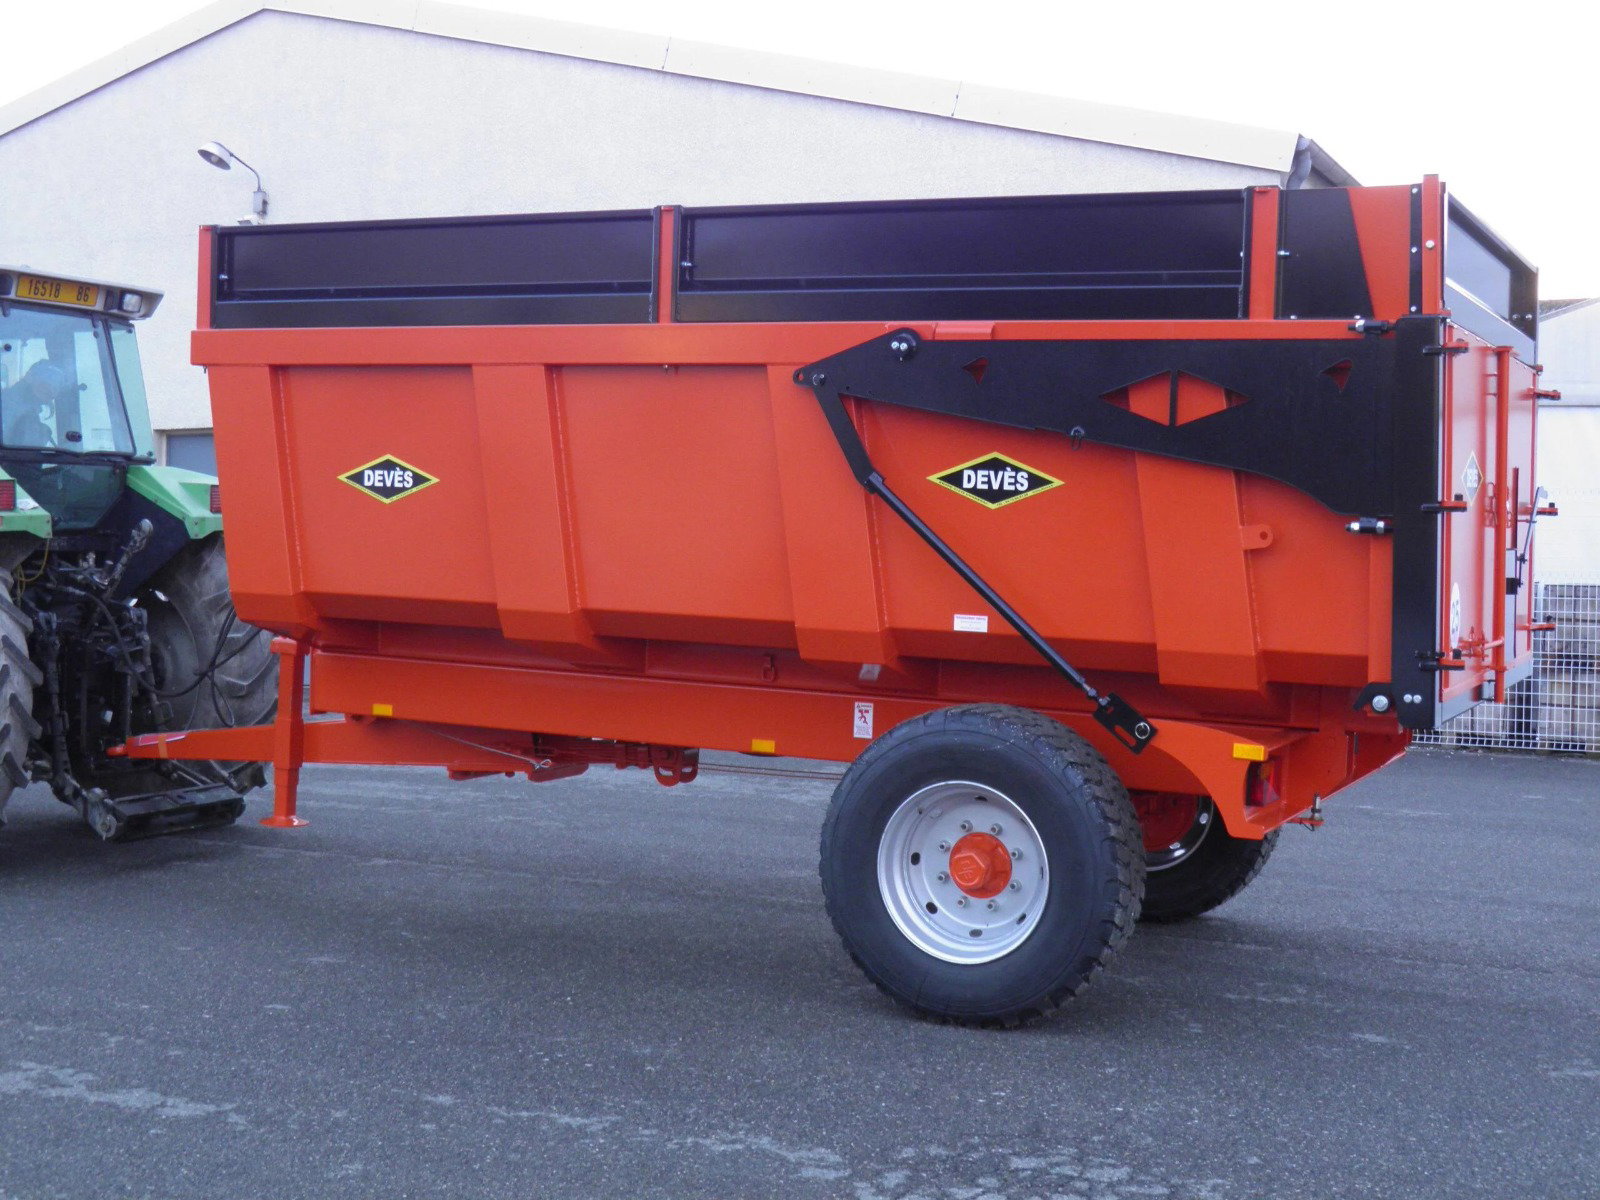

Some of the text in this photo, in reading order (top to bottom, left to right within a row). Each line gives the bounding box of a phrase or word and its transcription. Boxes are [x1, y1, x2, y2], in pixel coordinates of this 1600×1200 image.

[28, 278, 91, 302] 16518 86
[363, 467, 414, 488] DEVÈS
[962, 467, 1029, 492] DEVÈS
